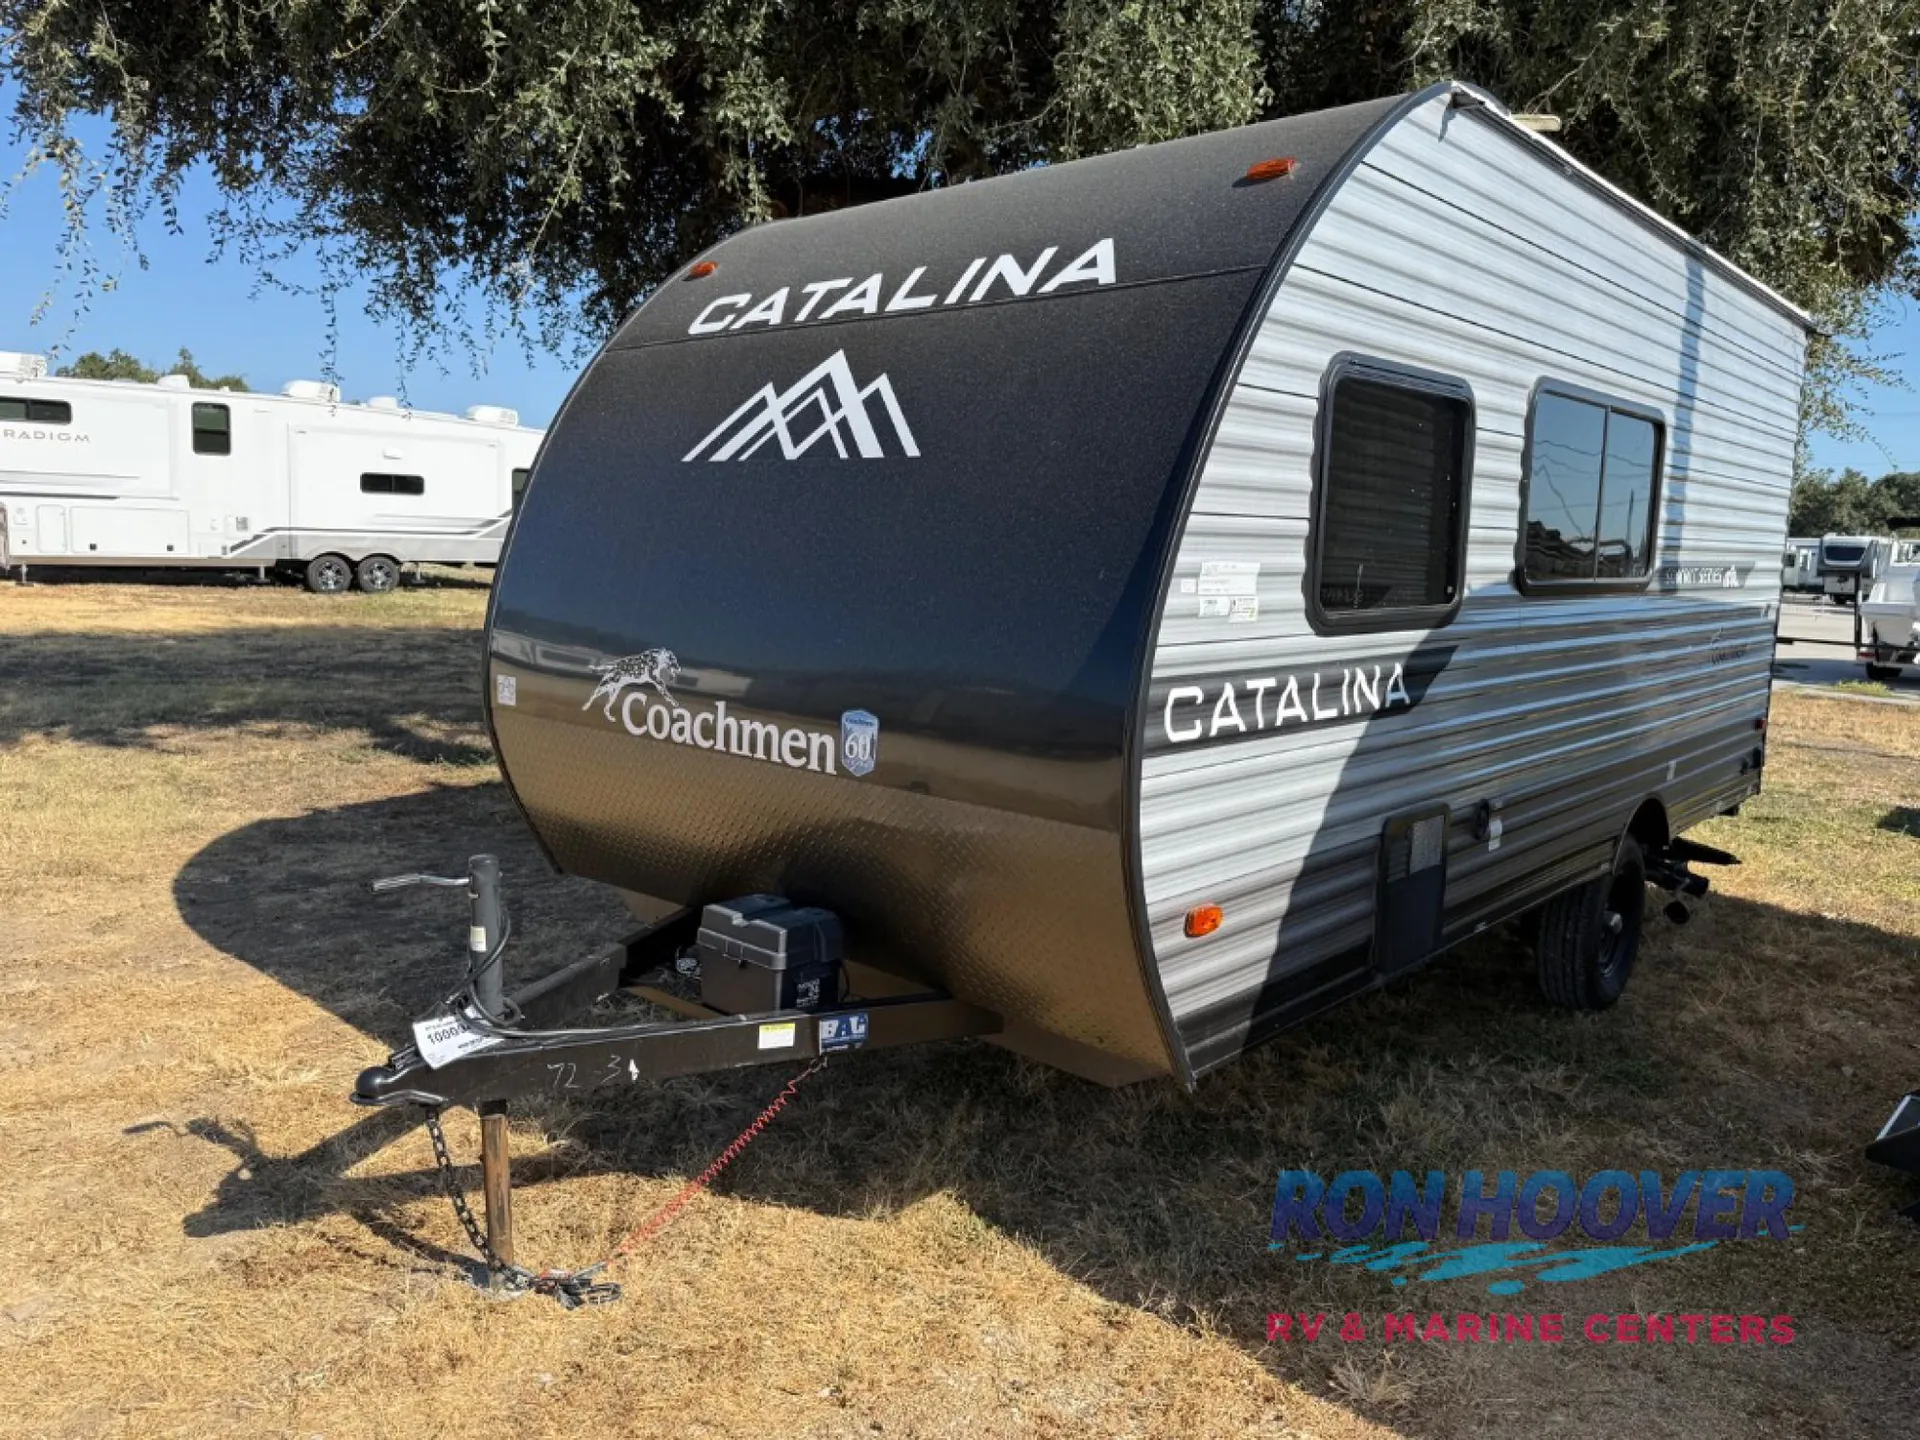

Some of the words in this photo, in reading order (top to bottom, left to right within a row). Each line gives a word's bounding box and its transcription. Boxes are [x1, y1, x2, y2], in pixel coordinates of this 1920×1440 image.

[688, 237, 1117, 335] CATALINA
[621, 691, 838, 775] Coachmen
[1163, 662, 1411, 743] CATALINA
